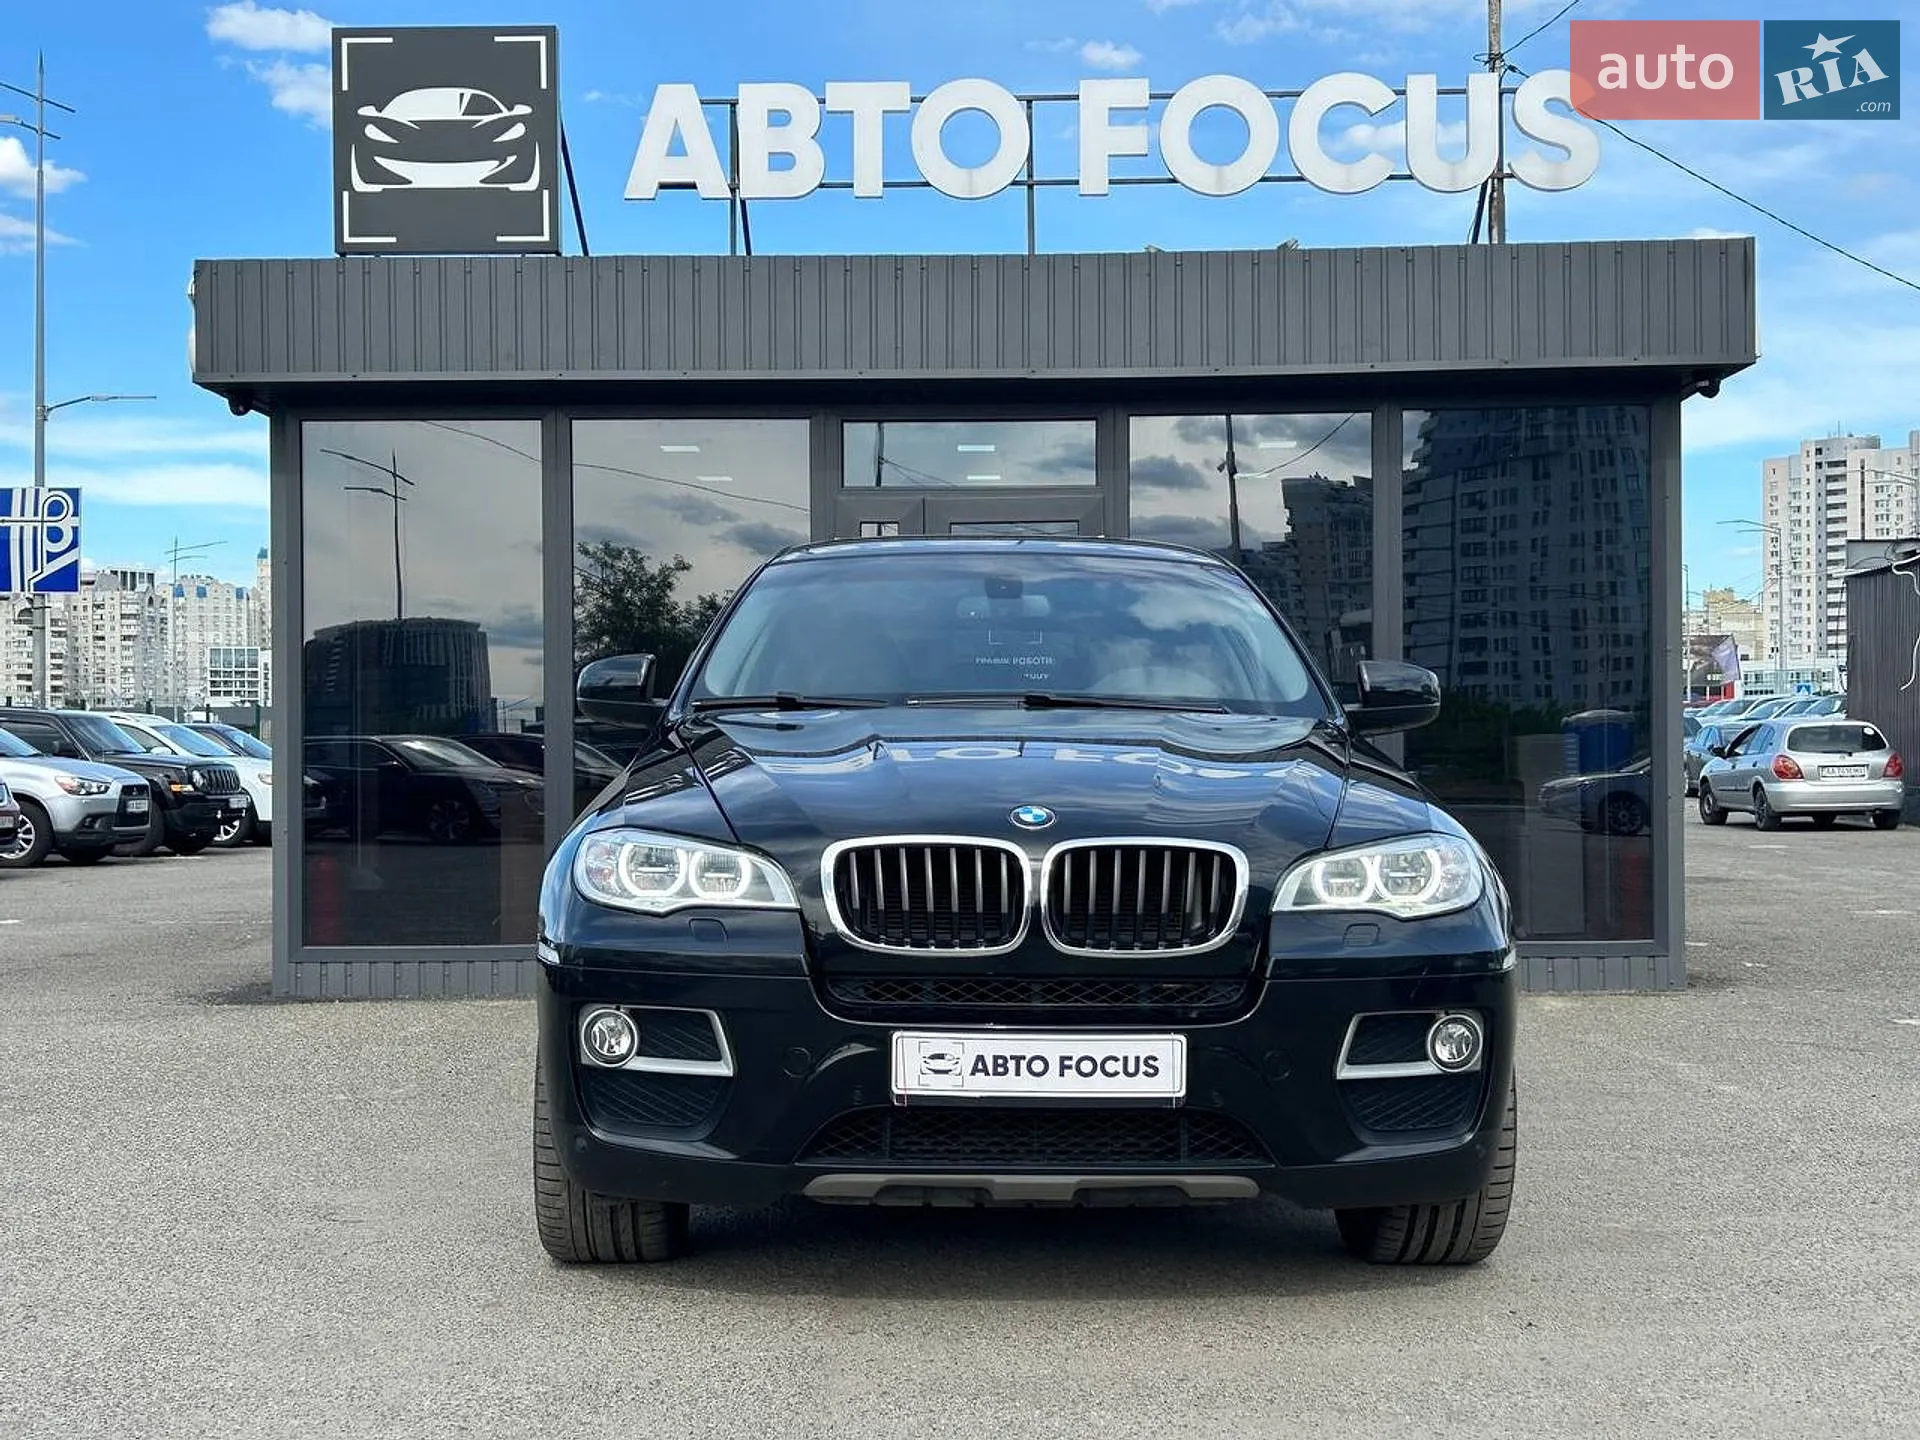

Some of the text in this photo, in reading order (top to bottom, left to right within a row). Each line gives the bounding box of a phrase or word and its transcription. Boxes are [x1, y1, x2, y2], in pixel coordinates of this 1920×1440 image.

[623, 69, 1602, 200] АВТО FOCUS
[969, 1054, 1160, 1079] АВТО FOCUS
